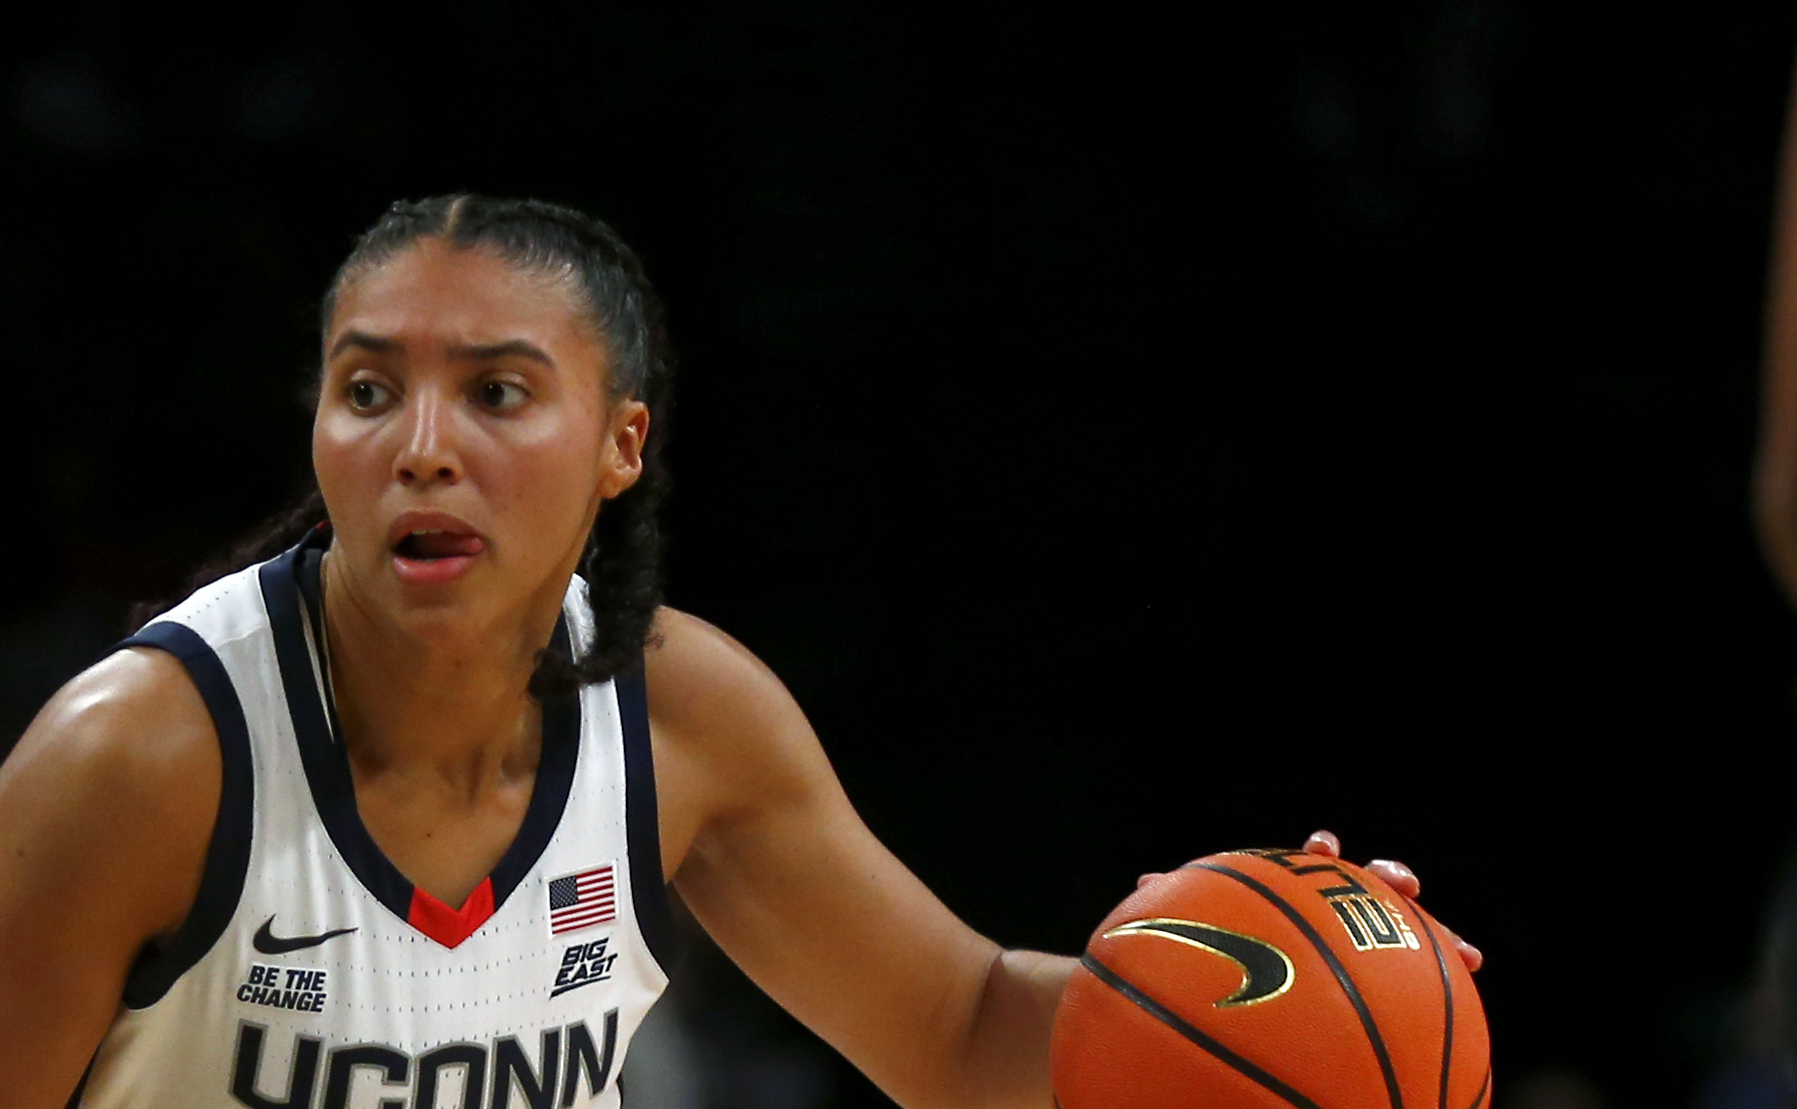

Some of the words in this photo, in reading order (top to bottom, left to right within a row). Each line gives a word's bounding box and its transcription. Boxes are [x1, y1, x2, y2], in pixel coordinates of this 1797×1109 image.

[562, 937, 609, 966] BIG
[248, 965, 280, 987] BE
[285, 968, 327, 991] THE
[554, 953, 618, 987] EAST
[236, 984, 327, 1013] CHANGE
